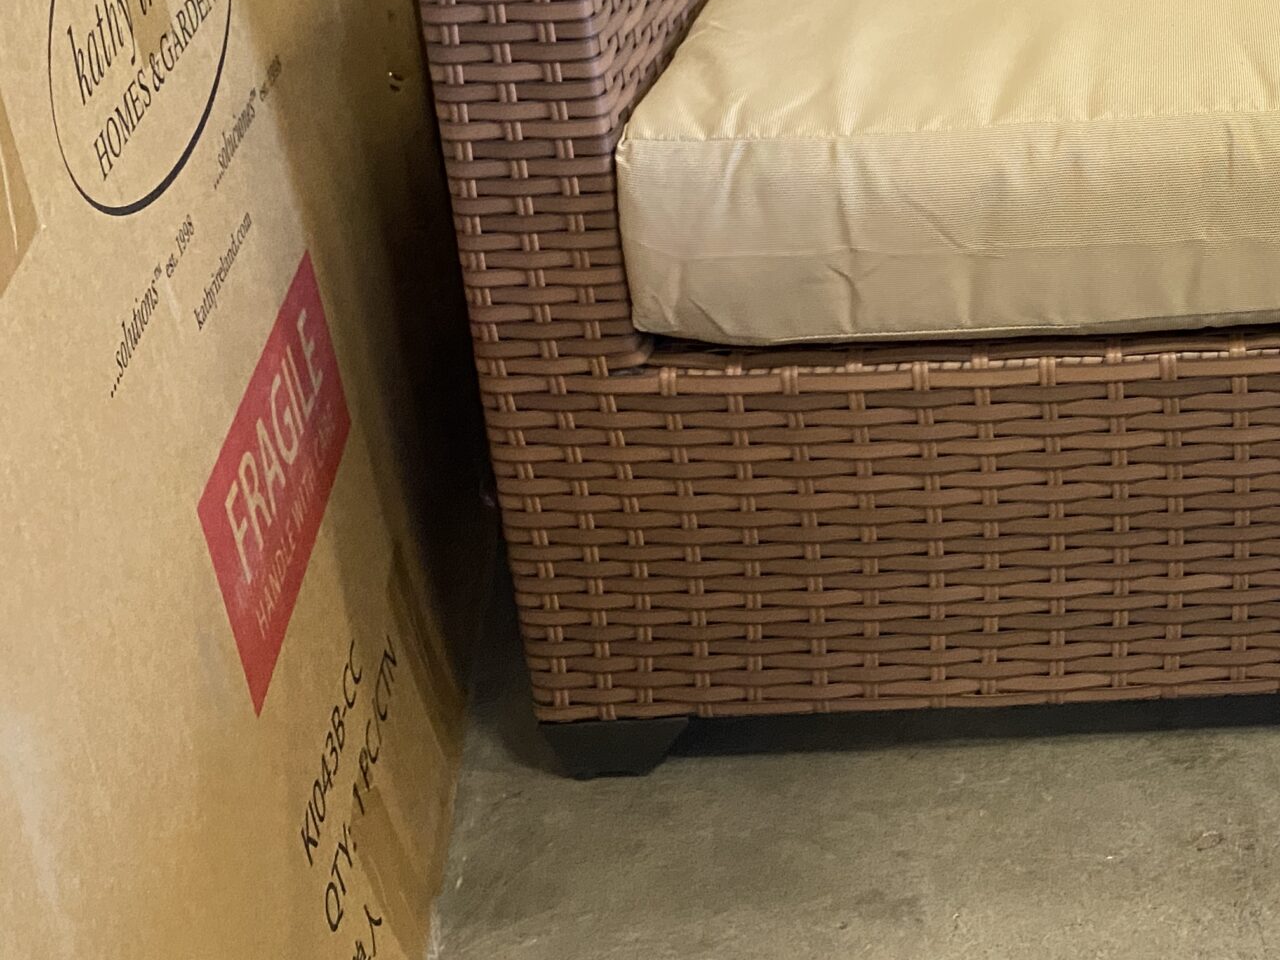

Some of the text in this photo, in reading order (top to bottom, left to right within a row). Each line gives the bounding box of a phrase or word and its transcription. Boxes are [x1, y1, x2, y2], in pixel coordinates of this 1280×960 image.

[93, 68, 152, 182] HOMES
[176, 213, 195, 258] 1998
[193, 211, 252, 332] kathyireland.com
[224, 306, 324, 586] FRAGILE
[255, 527, 298, 639] HANDLE
[278, 458, 316, 534] WITH
[324, 821, 358, 933] QTY:
